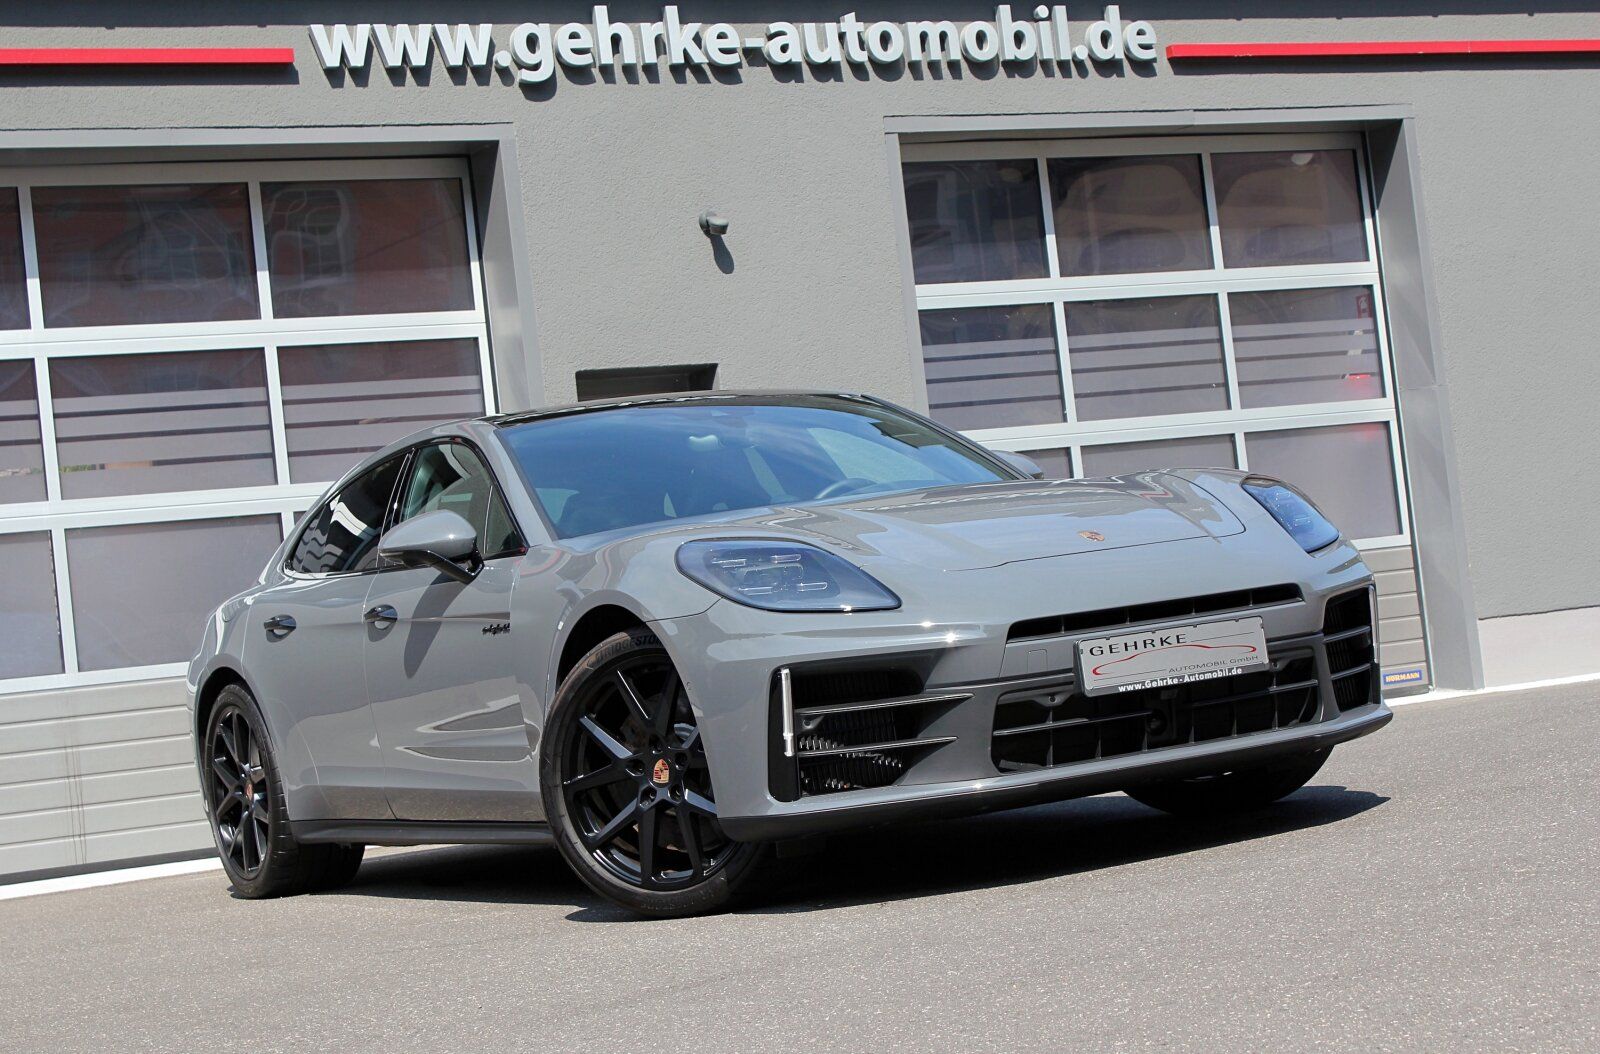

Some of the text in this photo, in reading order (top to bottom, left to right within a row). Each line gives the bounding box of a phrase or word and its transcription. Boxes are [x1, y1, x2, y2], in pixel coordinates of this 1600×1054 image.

[308, 5, 1157, 83] www.gehrke-automobil.de
[1089, 633, 1187, 657] GEHRKE
[1168, 655, 1258, 673] AUTOMOBIL GmbH
